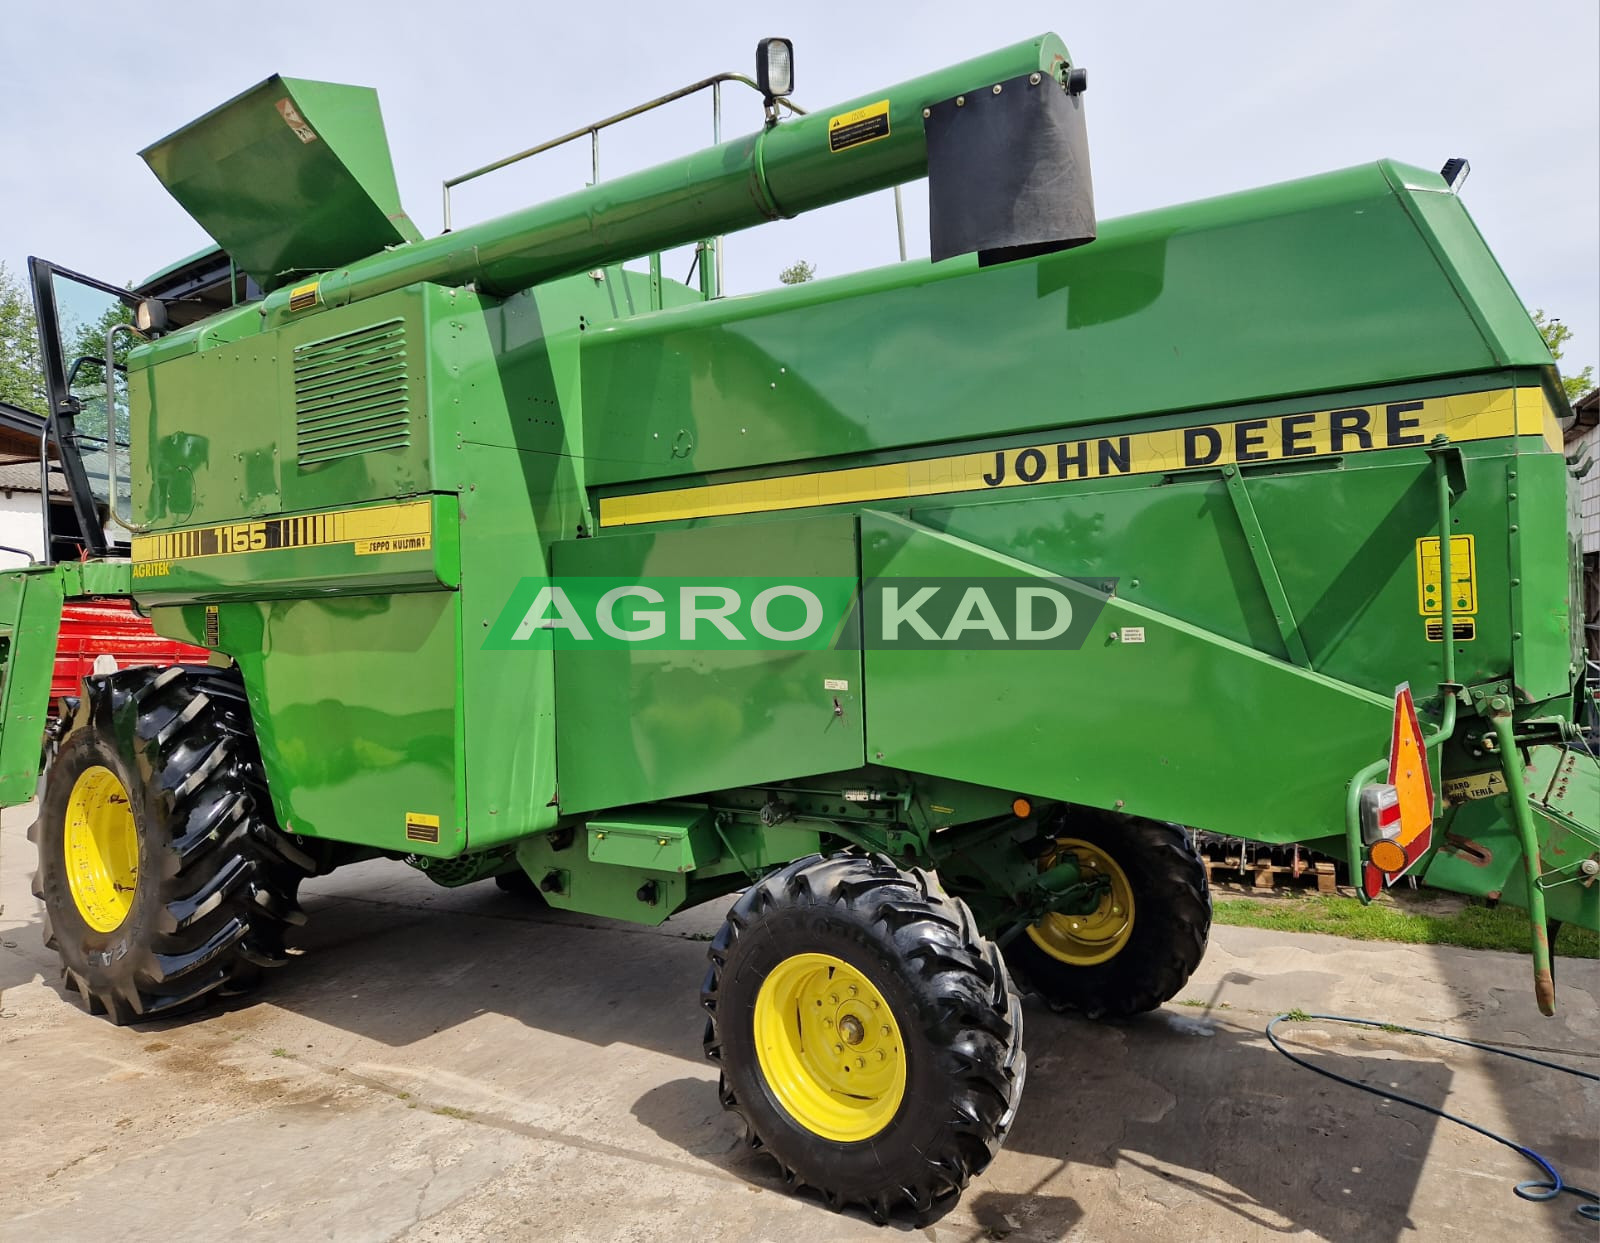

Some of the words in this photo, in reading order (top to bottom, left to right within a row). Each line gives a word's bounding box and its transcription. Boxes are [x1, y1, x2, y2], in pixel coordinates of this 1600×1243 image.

[982, 436, 1131, 487] JOHN
[1183, 401, 1426, 467] DEERE
[213, 521, 267, 554] 1155
[132, 561, 170, 579] AGRITEK
